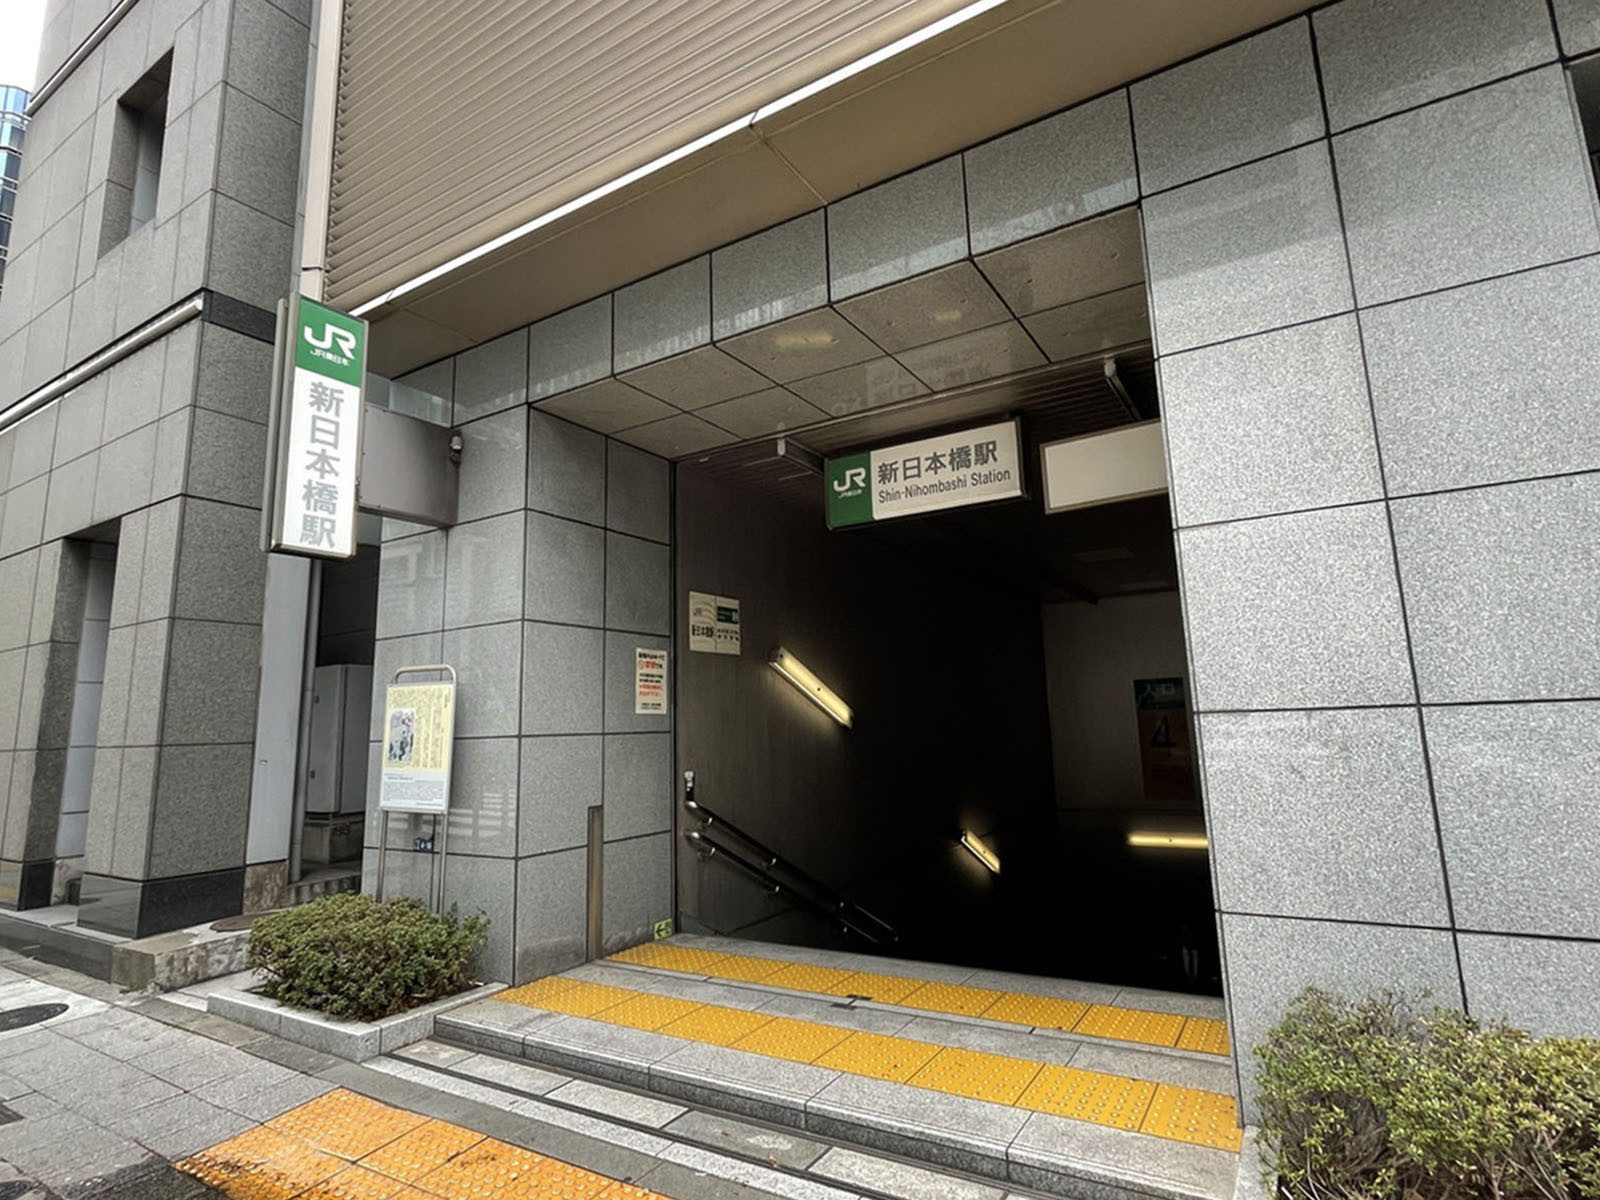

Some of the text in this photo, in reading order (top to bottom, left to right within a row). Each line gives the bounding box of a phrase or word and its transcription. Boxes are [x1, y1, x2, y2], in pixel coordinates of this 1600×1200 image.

[304, 323, 357, 360] JR
[299, 381, 344, 549] 新日本橋駅
[834, 467, 867, 492] JR
[877, 440, 998, 486] 新日本橋駅
[878, 475, 967, 504] Shin-Nihombashi
[971, 468, 1011, 487] Station
